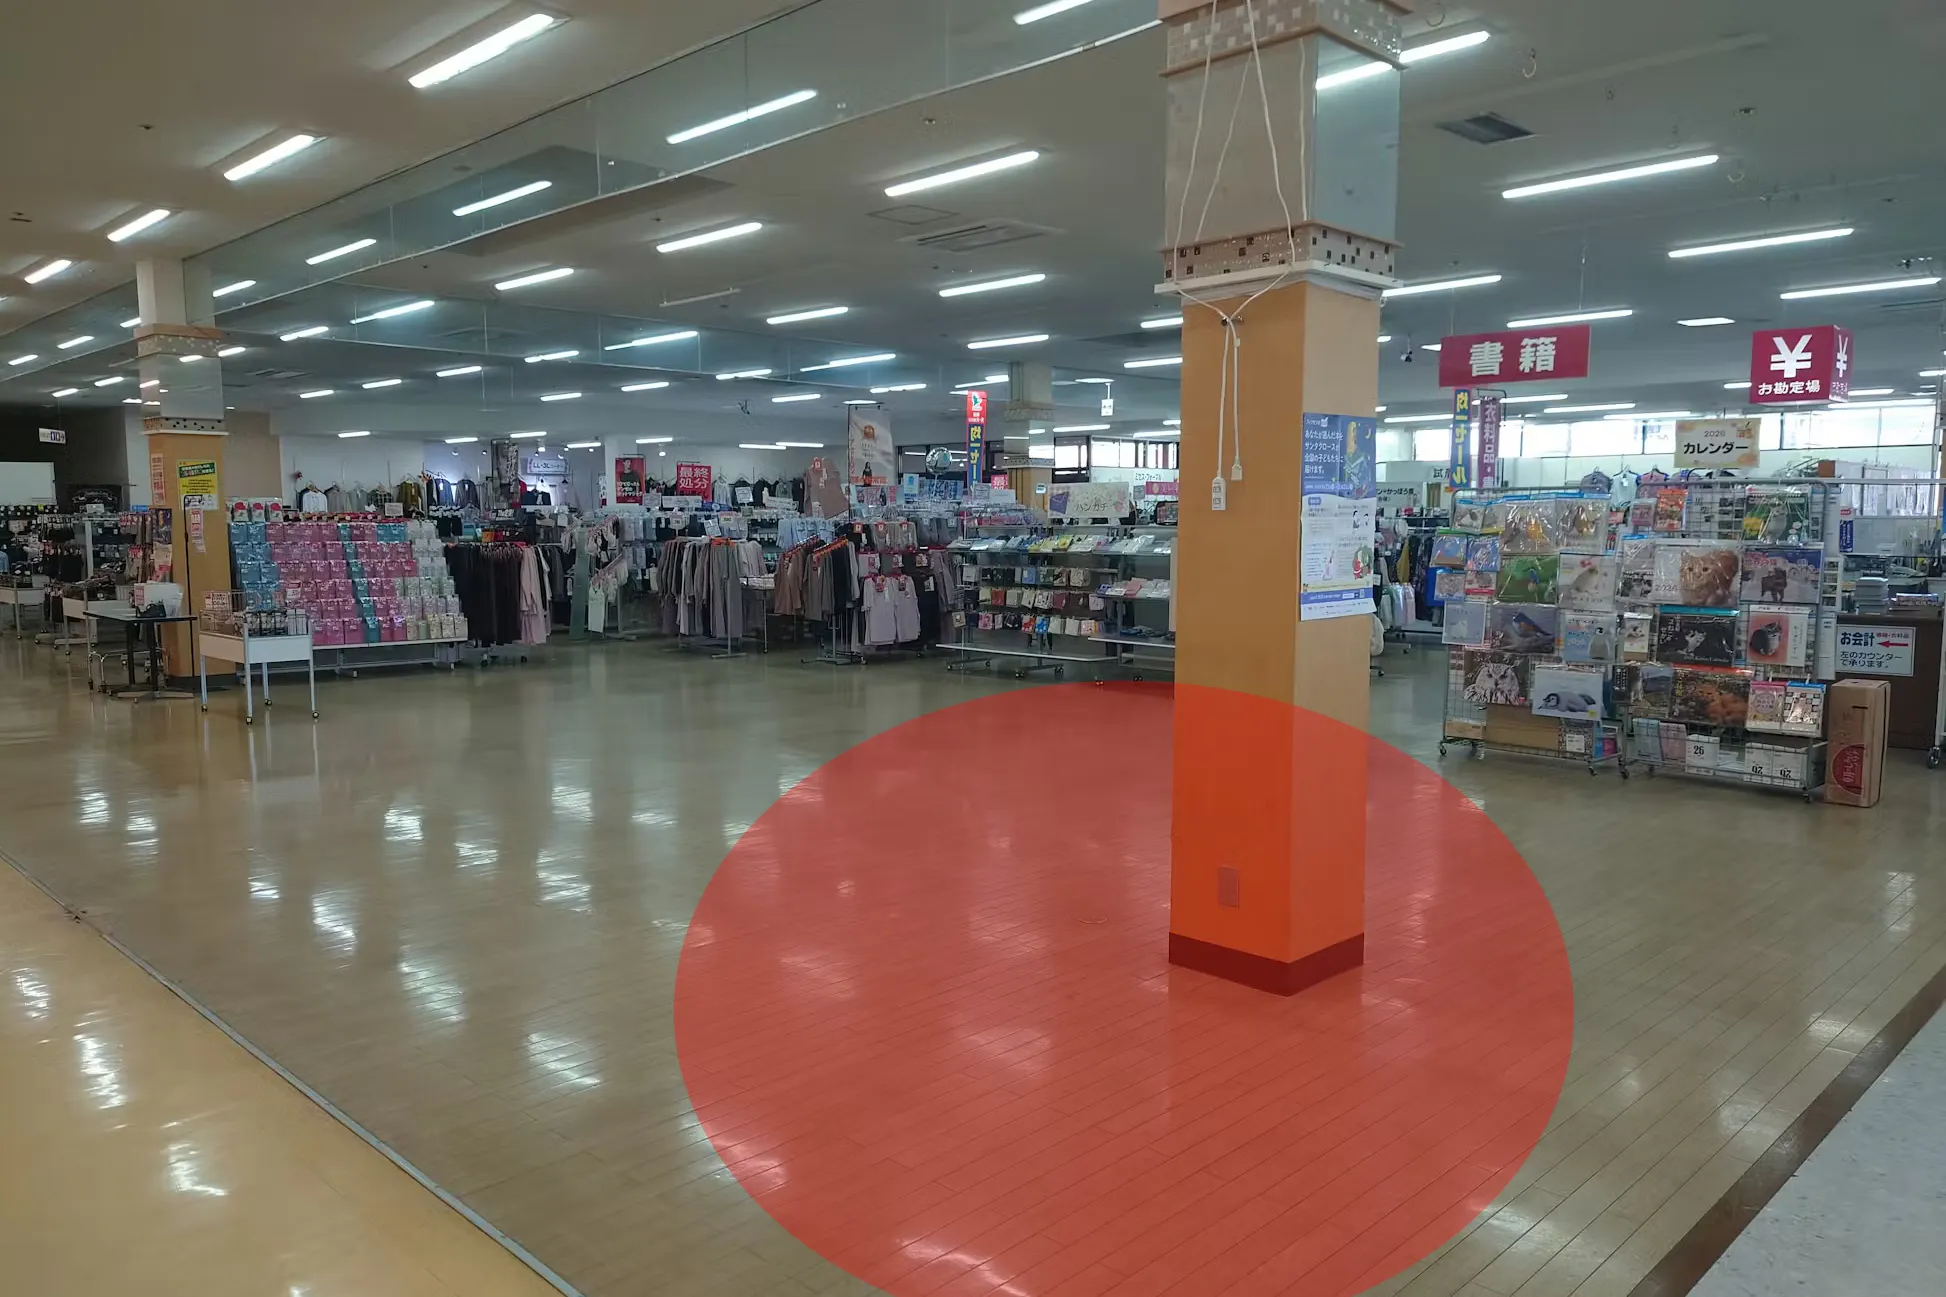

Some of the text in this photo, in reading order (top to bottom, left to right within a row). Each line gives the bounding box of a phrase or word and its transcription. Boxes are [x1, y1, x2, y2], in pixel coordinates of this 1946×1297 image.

[1469, 337, 1557, 377] 書籍
[1757, 380, 1821, 396] お勘定場
[1684, 441, 1748, 455] カレンダー
[679, 466, 709, 479] 最終
[679, 479, 709, 489] 処分
[1076, 501, 1108, 512] ハンカチ
[1840, 631, 1875, 647] お会計
[1841, 650, 1903, 661] 左のカウンター
[1841, 658, 1889, 669] で承ります。
[1693, 745, 1705, 756] 26
